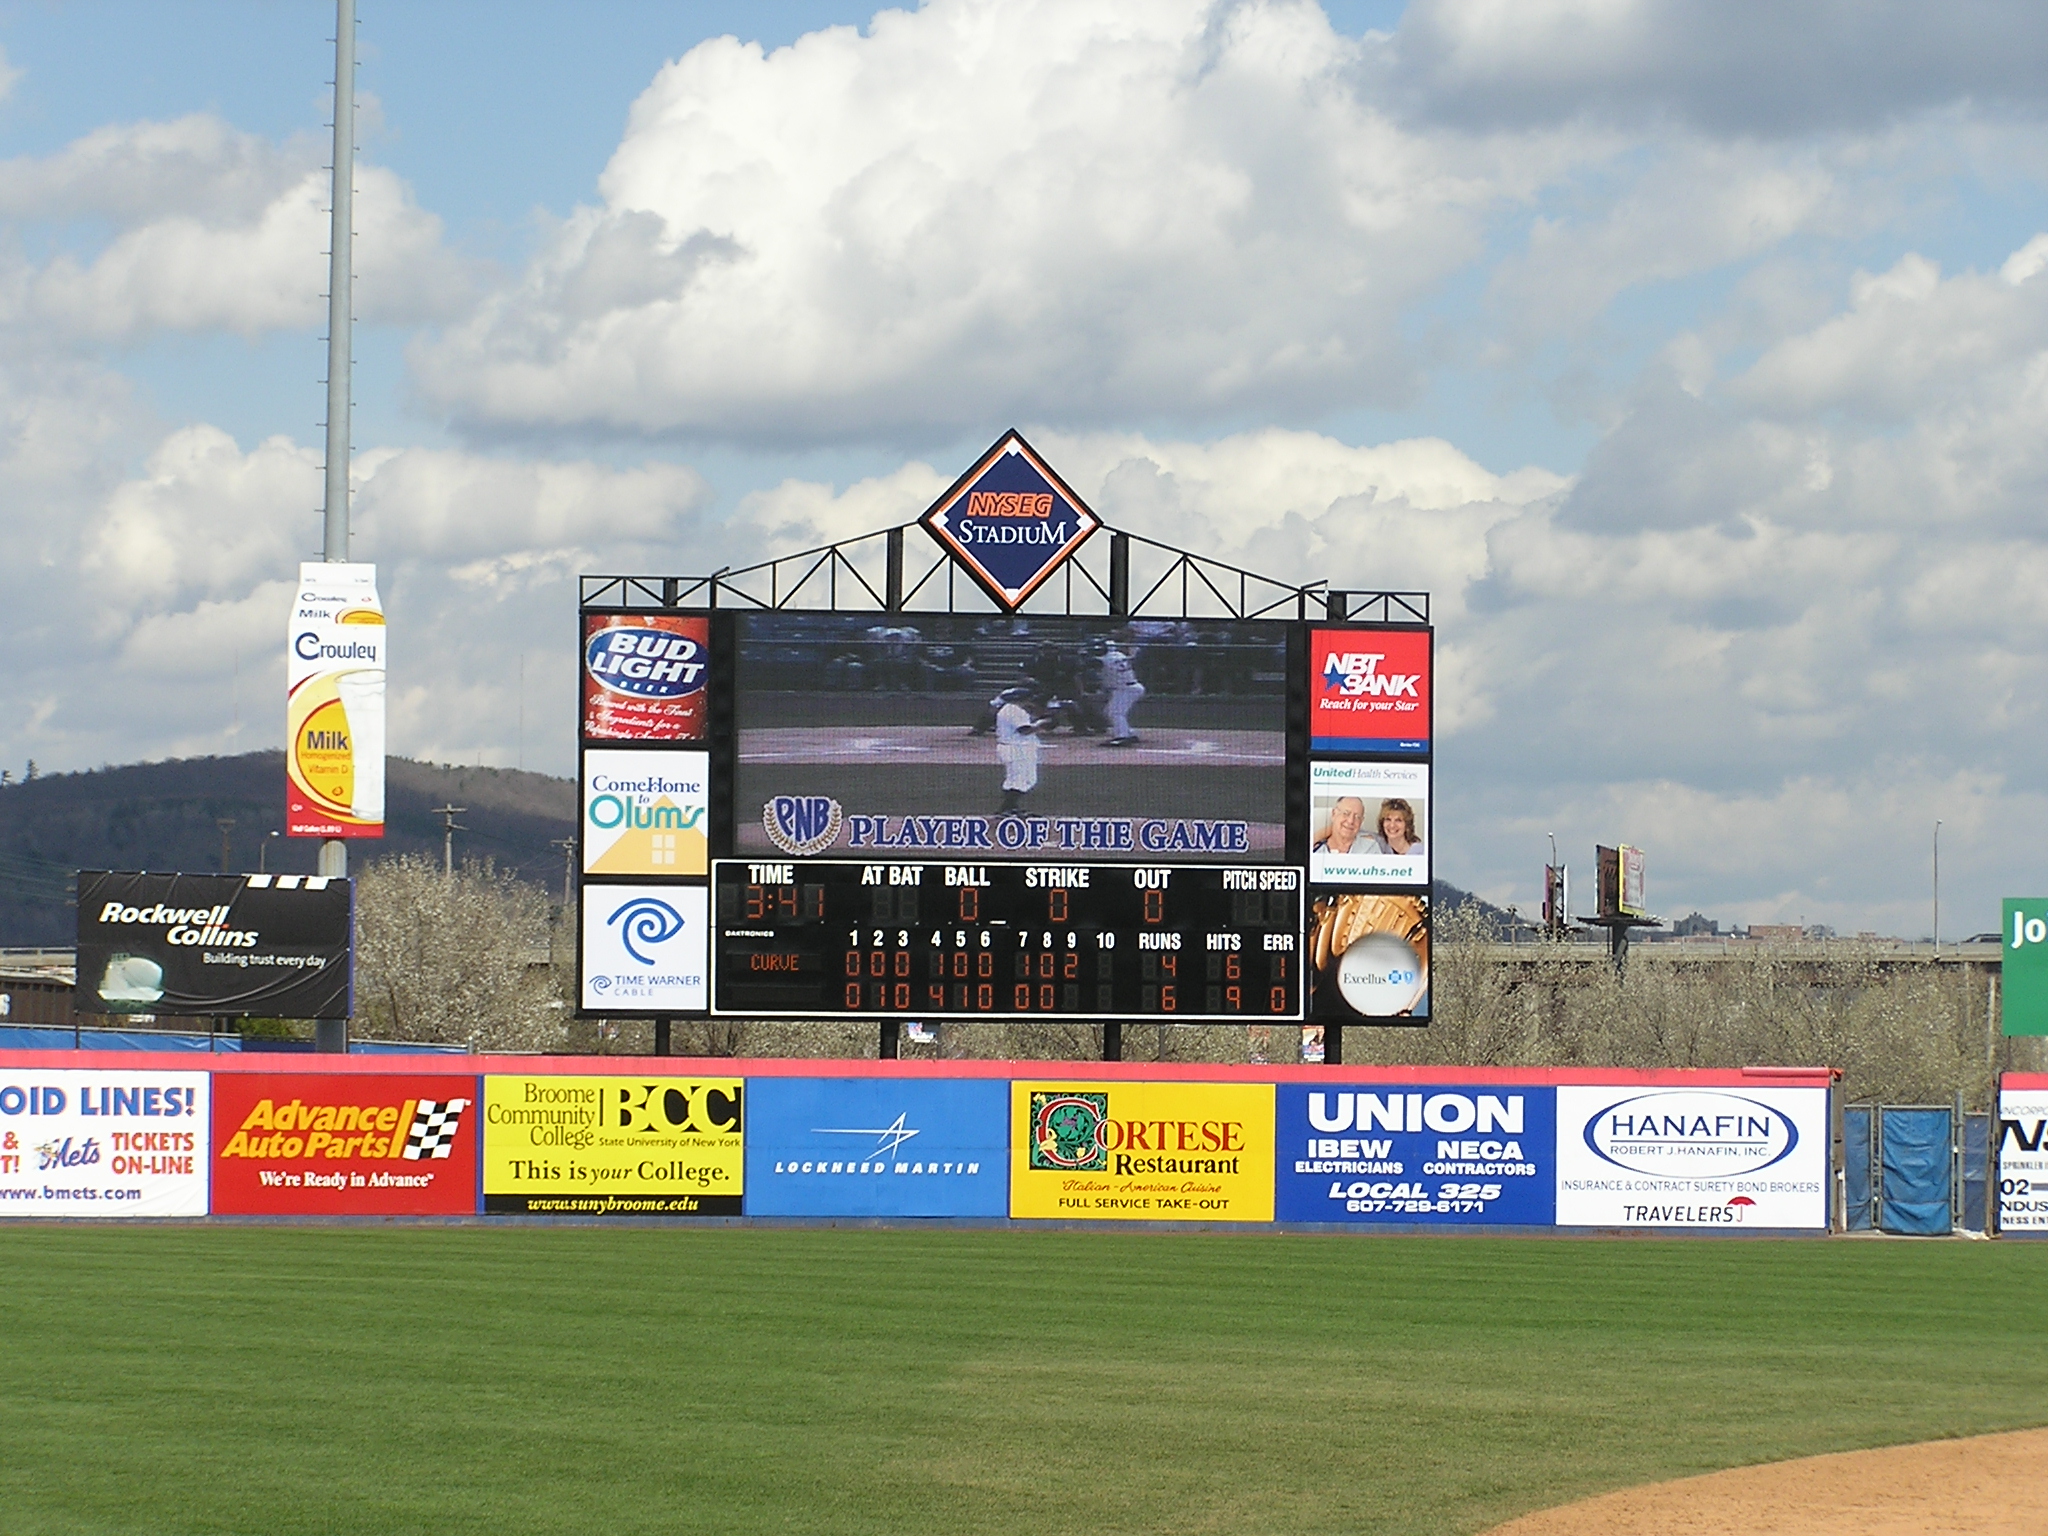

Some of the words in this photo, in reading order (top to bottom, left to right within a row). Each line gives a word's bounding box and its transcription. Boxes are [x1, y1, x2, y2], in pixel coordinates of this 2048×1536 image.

[966, 492, 1053, 518] NYSEG
[299, 609, 331, 618] Milk
[295, 632, 376, 662] Crowley
[608, 632, 697, 661] BUD
[592, 651, 705, 683] LIGHT
[1324, 653, 1385, 675] NBT
[1340, 674, 1421, 697] BANK
[1320, 698, 1351, 710] Reach
[1352, 699, 1368, 712] for
[1369, 701, 1394, 712] your
[307, 730, 348, 750] Milk
[1383, 769, 1418, 780] Services
[639, 794, 650, 804] to
[589, 794, 705, 829] Olum's
[849, 815, 993, 848] PLAYER
[996, 817, 1050, 850] OF
[1056, 818, 1134, 850] THE
[1141, 819, 1249, 852] GAME
[748, 865, 794, 885] TIME
[861, 866, 884, 885] AT
[889, 866, 923, 886] BAT
[945, 867, 991, 887] BALL
[1025, 868, 1090, 888] STRIKE
[1134, 869, 1172, 889] OUT
[1223, 870, 1257, 890] PITCH
[1260, 871, 1296, 890] SPEED
[1324, 866, 1413, 876] www.uhs.net
[99, 902, 230, 925] Rockwell
[747, 886, 823, 919] 3:41
[960, 888, 978, 921] 0
[1050, 889, 1067, 921] 0
[1145, 890, 1162, 922] 0
[166, 925, 259, 947] Collins
[850, 930, 858, 946] 1
[873, 931, 883, 946] 2
[898, 931, 908, 947] 3
[931, 931, 941, 947] 4
[956, 931, 966, 947] 5
[981, 931, 990, 947] 6
[1019, 931, 1028, 947] 7
[1042, 932, 1052, 948] 8
[1067, 932, 1076, 949] 9
[1097, 933, 1114, 949] 10
[1139, 933, 1181, 950] RUNS
[1206, 934, 1241, 950] HITS
[1263, 935, 1294, 951] ERR
[203, 952, 248, 967] Building
[249, 954, 274, 965] trust
[275, 956, 304, 969] every
[306, 955, 326, 969] day
[751, 954, 799, 971] CURVE
[846, 951, 860, 976] 0
[871, 951, 885, 976] 0
[895, 951, 909, 976] 0
[954, 952, 968, 977] 0
[979, 952, 992, 977] 0
[1040, 954, 1054, 978] 0
[1064, 954, 1078, 978] 2
[1162, 955, 1176, 977] 4
[1227, 954, 1240, 979] 6
[615, 975, 645, 985] TIME
[648, 975, 701, 986] WARNER
[1343, 973, 1387, 984] Excellus
[615, 988, 653, 996] CABLE
[846, 983, 860, 1008] 0
[895, 983, 909, 1008] 0
[929, 985, 944, 1007] 4
[978, 984, 992, 1009] 0
[1015, 984, 1029, 1010] 0
[1040, 984, 1054, 1009] 0
[1162, 986, 1176, 1011] 6
[1227, 986, 1240, 1009] 9
[1271, 986, 1285, 1012] 0
[0, 1086, 67, 1115] OID
[81, 1087, 195, 1117] LINES!
[524, 1083, 595, 1103] Broome
[241, 1099, 398, 1131] Advance
[488, 1104, 595, 1129] Community
[620, 1085, 741, 1133] BCC
[1308, 1092, 1524, 1133] UNION
[1612, 1115, 1770, 1137] HANAFIN
[3, 1131, 18, 1150] &
[111, 1132, 194, 1151] TICKETS
[220, 1131, 303, 1159] Auto
[304, 1132, 390, 1159] Parts
[530, 1126, 594, 1150] College
[599, 1137, 624, 1147] State
[627, 1137, 677, 1148] University
[679, 1137, 691, 1147] of
[692, 1137, 716, 1147] New
[718, 1138, 740, 1147] York
[1308, 1139, 1392, 1158] IBEW
[1437, 1140, 1524, 1160] NECA
[1610, 1146, 1663, 1155] ROBERT
[1744, 1147, 1771, 1156] INC.
[111, 1156, 194, 1174] ON-LINE
[509, 1160, 561, 1180] This
[569, 1161, 587, 1180] is
[590, 1166, 632, 1185] your
[638, 1161, 730, 1187] College.
[775, 1161, 885, 1174] LOCKHEED
[894, 1162, 980, 1174] MARTIN
[1115, 1154, 1239, 1176] Restaurant
[1295, 1161, 1403, 1174] ELECTRICIANS
[1423, 1162, 1536, 1176] CONTRACTORS
[259, 1171, 301, 1187] We're
[304, 1171, 348, 1190] Ready
[350, 1172, 365, 1187] in
[1181, 1181, 1222, 1193] Cuisine
[1561, 1180, 1622, 1190] INSURANCE
[1625, 1181, 1632, 1191] &
[1634, 1181, 1690, 1192] CONTRACT
[1694, 1182, 1734, 1192] SURETY
[1737, 1182, 1767, 1193] BOND
[1770, 1182, 1820, 1193] BROKERS
[1329, 1182, 1428, 1199] LOCAL
[1438, 1183, 1502, 1200] 325
[527, 1197, 699, 1215] www.sunybroome.edu
[1059, 1198, 1090, 1208] FULL
[1095, 1198, 1150, 1209] SERVICE
[1155, 1199, 1230, 1209] TAKE-OUT
[1346, 1200, 1484, 1213] 607-729-6171
[1623, 1205, 1733, 1222] TRAVELERS
